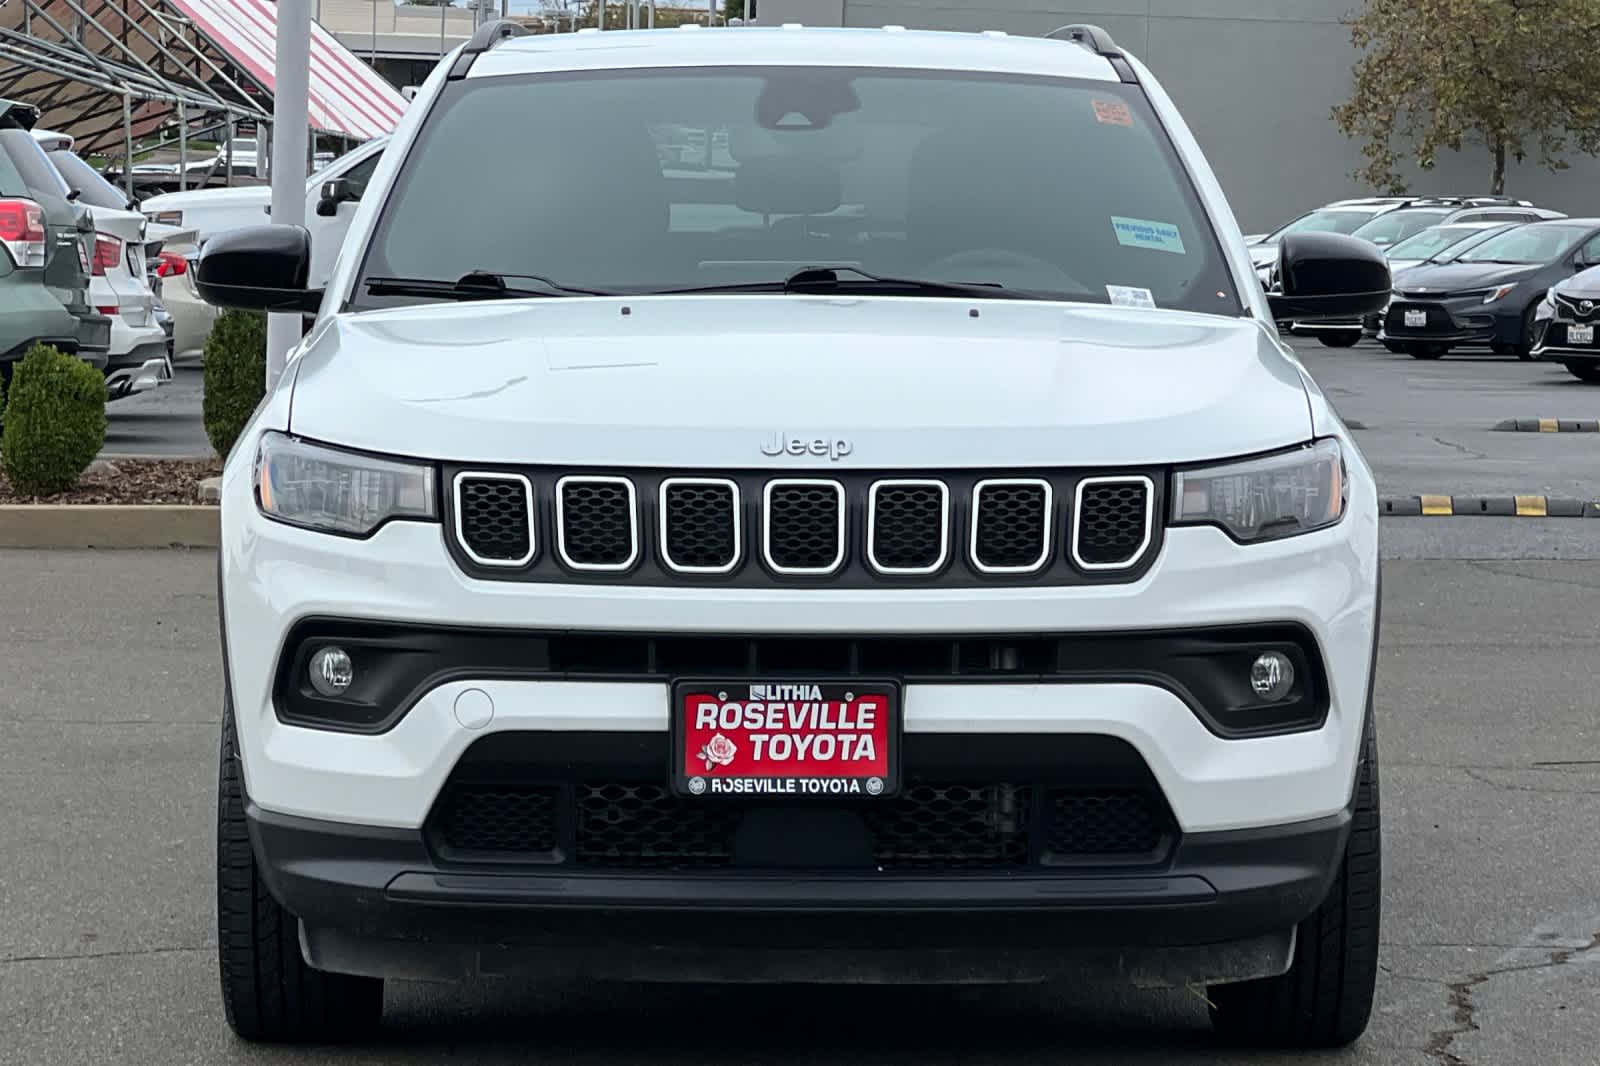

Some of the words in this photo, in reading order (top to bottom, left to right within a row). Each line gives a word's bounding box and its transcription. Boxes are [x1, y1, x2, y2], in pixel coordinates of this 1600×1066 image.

[760, 431, 853, 461] Jeep
[766, 685, 823, 701] LITHIA
[695, 702, 877, 730] ROSEVILLE
[749, 733, 876, 761] TOYOTA
[711, 778, 796, 793] ROSEVILLE
[799, 778, 861, 793] TOYOTA
